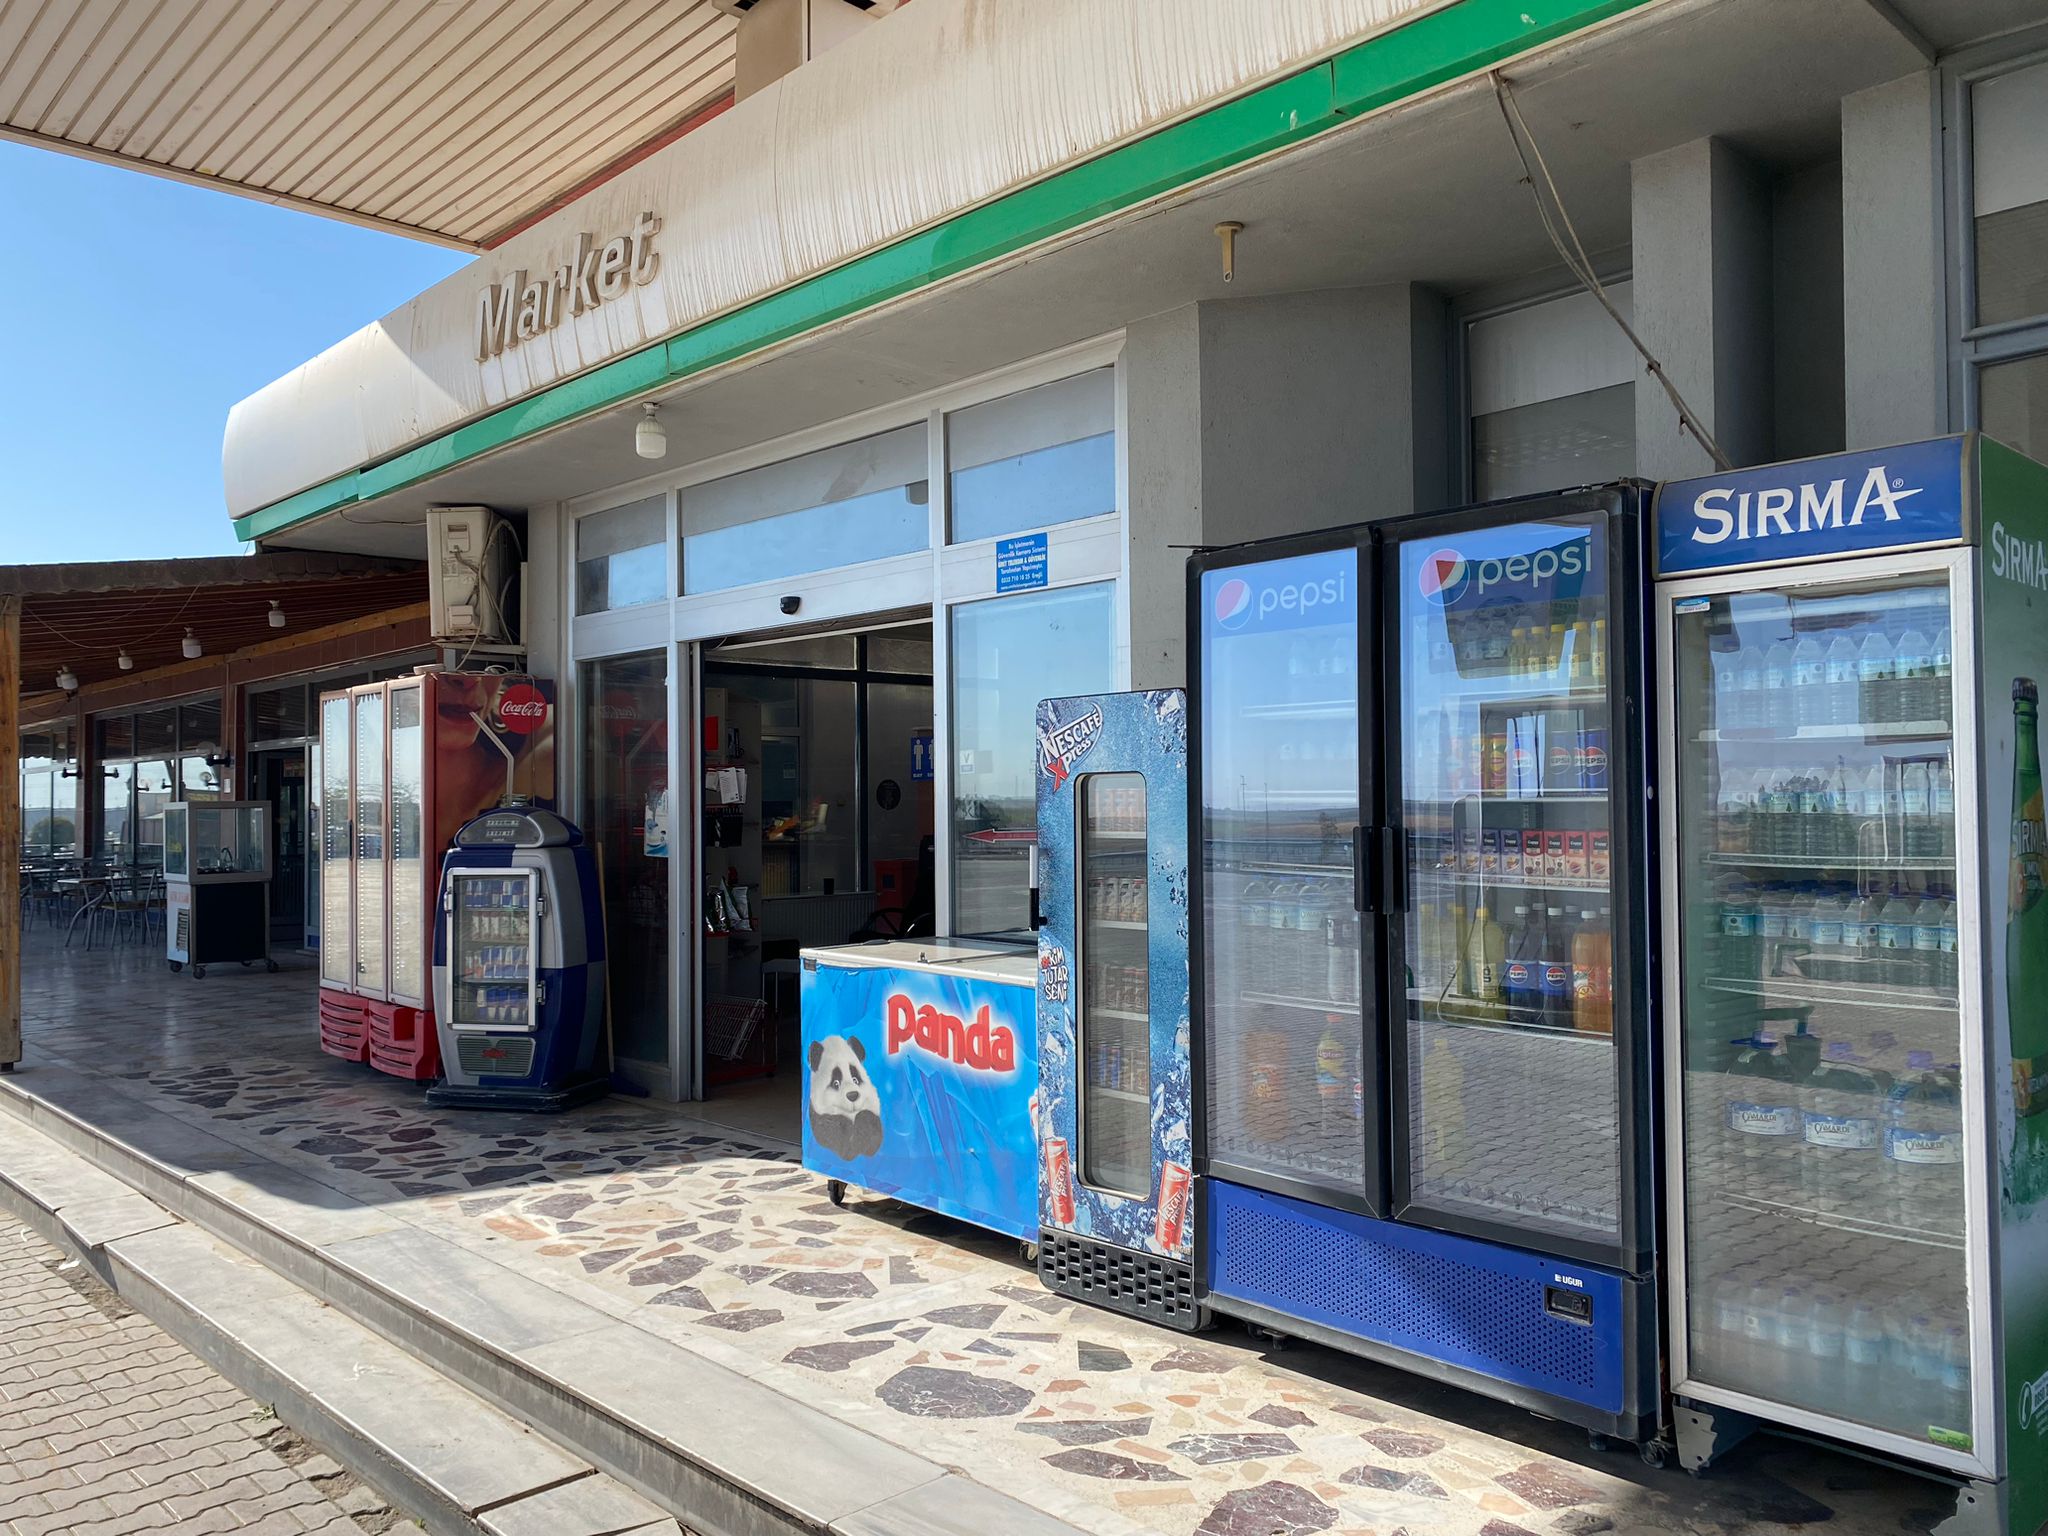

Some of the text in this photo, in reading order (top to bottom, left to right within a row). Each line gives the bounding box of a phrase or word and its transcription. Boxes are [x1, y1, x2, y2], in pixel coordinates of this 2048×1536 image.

[475, 211, 662, 362] Market
[1479, 536, 1592, 595] pepsi
[1260, 571, 1344, 620] pepsi
